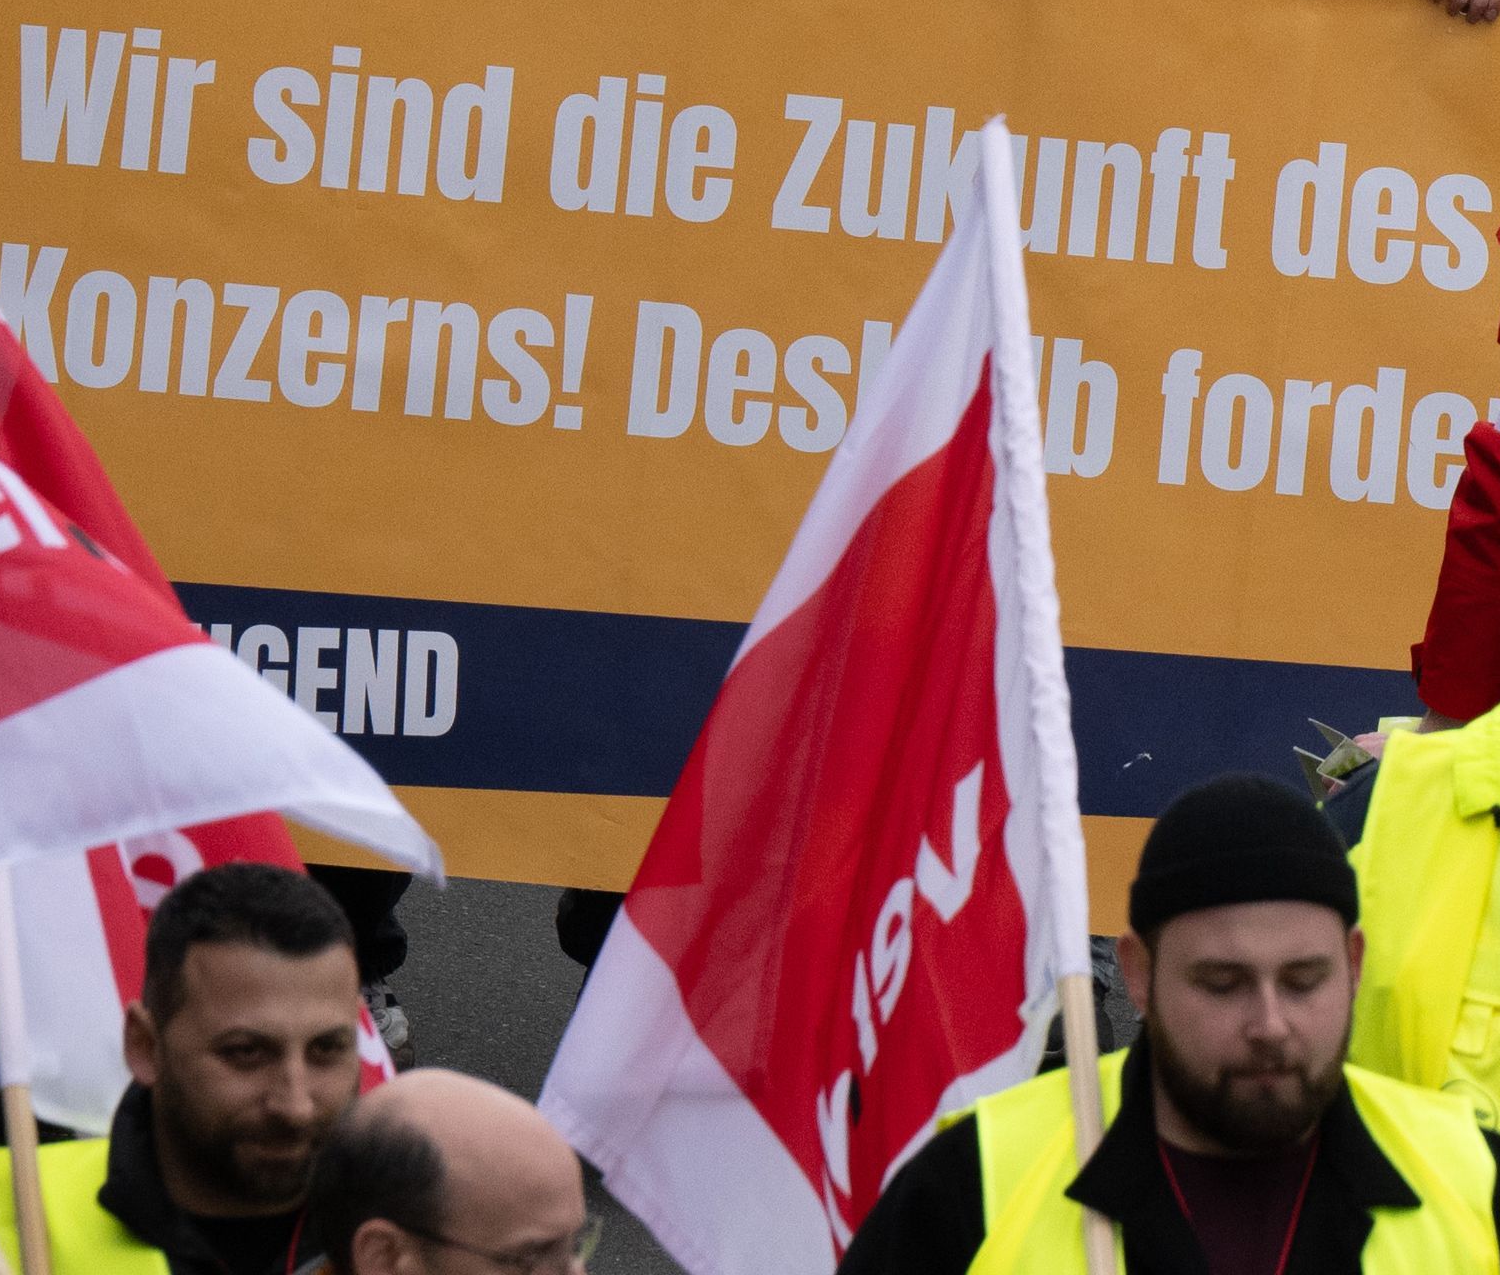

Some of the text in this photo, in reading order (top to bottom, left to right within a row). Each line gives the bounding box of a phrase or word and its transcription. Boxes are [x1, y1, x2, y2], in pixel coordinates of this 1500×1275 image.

[18, 24, 1494, 293] Wir sind die Zukunft des
[1, 242, 592, 432] Konzerns!
